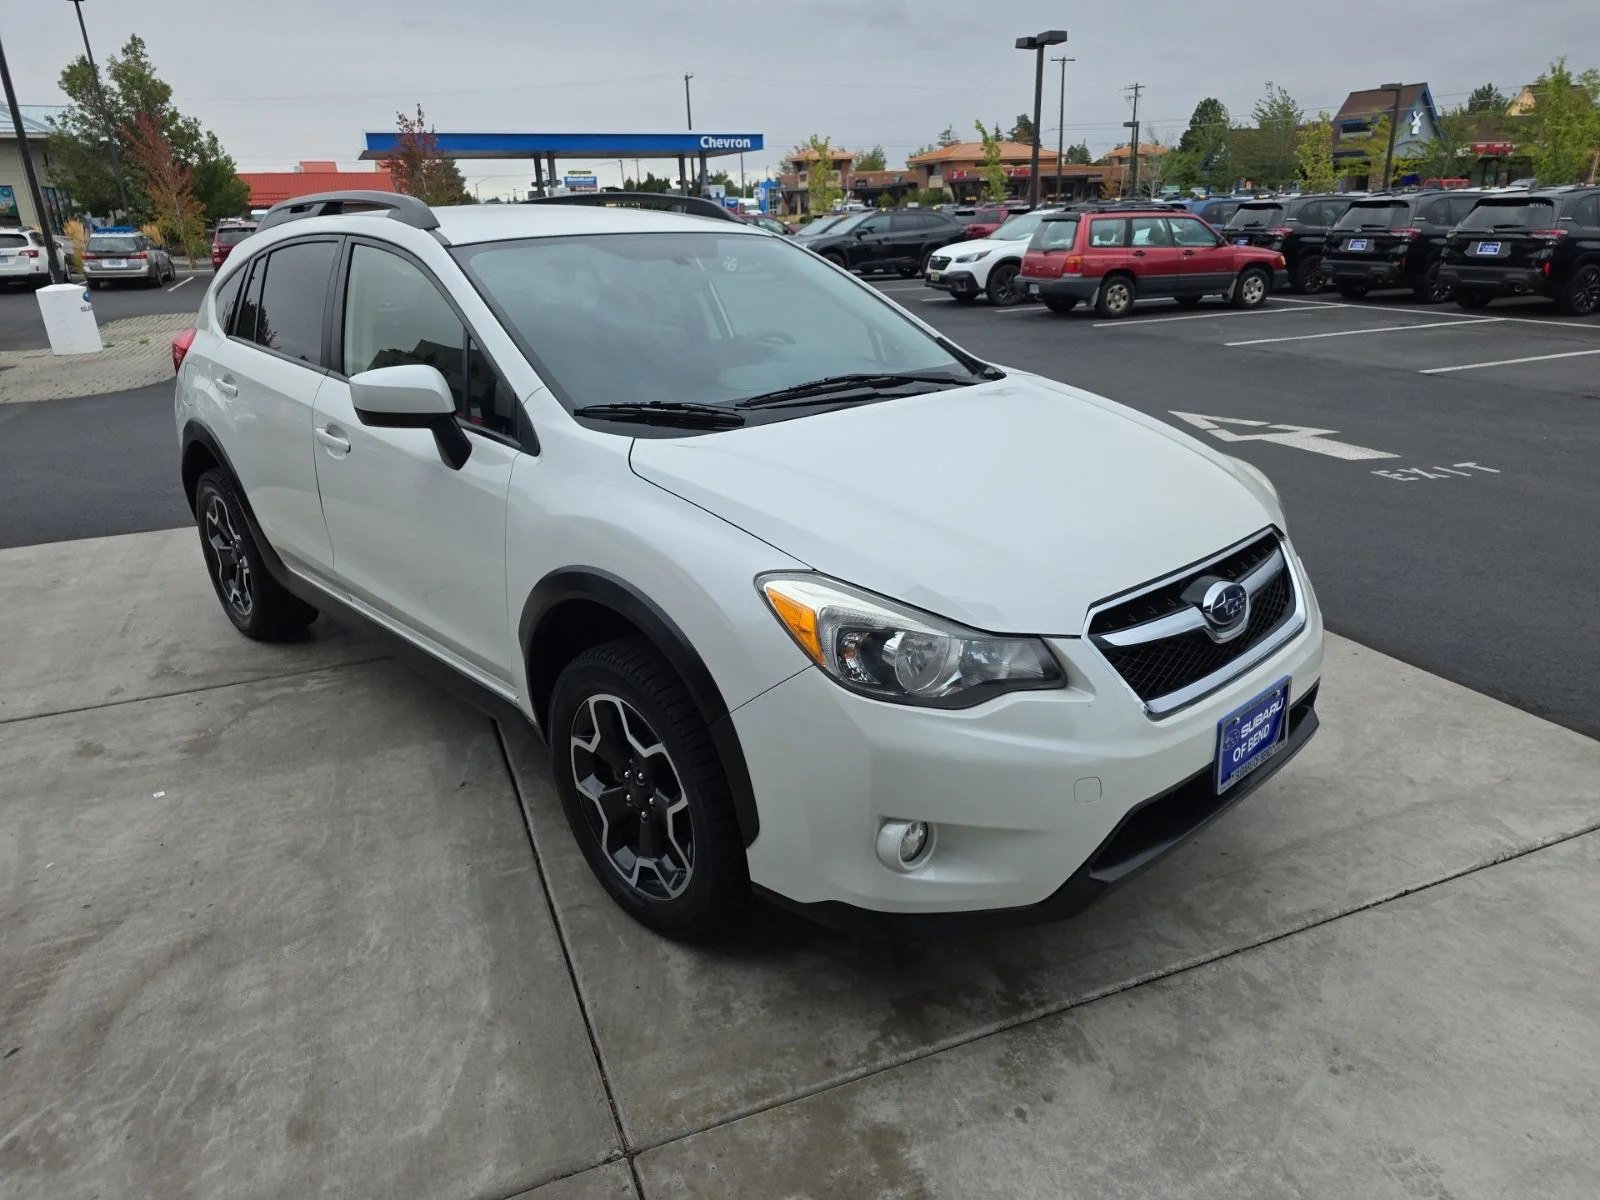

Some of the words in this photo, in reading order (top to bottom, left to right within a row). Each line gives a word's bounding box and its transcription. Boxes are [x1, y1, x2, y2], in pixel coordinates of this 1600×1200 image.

[700, 136, 750, 148] Chevron
[1370, 462, 1500, 481] EXIT
[1240, 697, 1284, 739] SUBARU
[1232, 742, 1247, 762] OF
[1247, 723, 1270, 752] BEND
